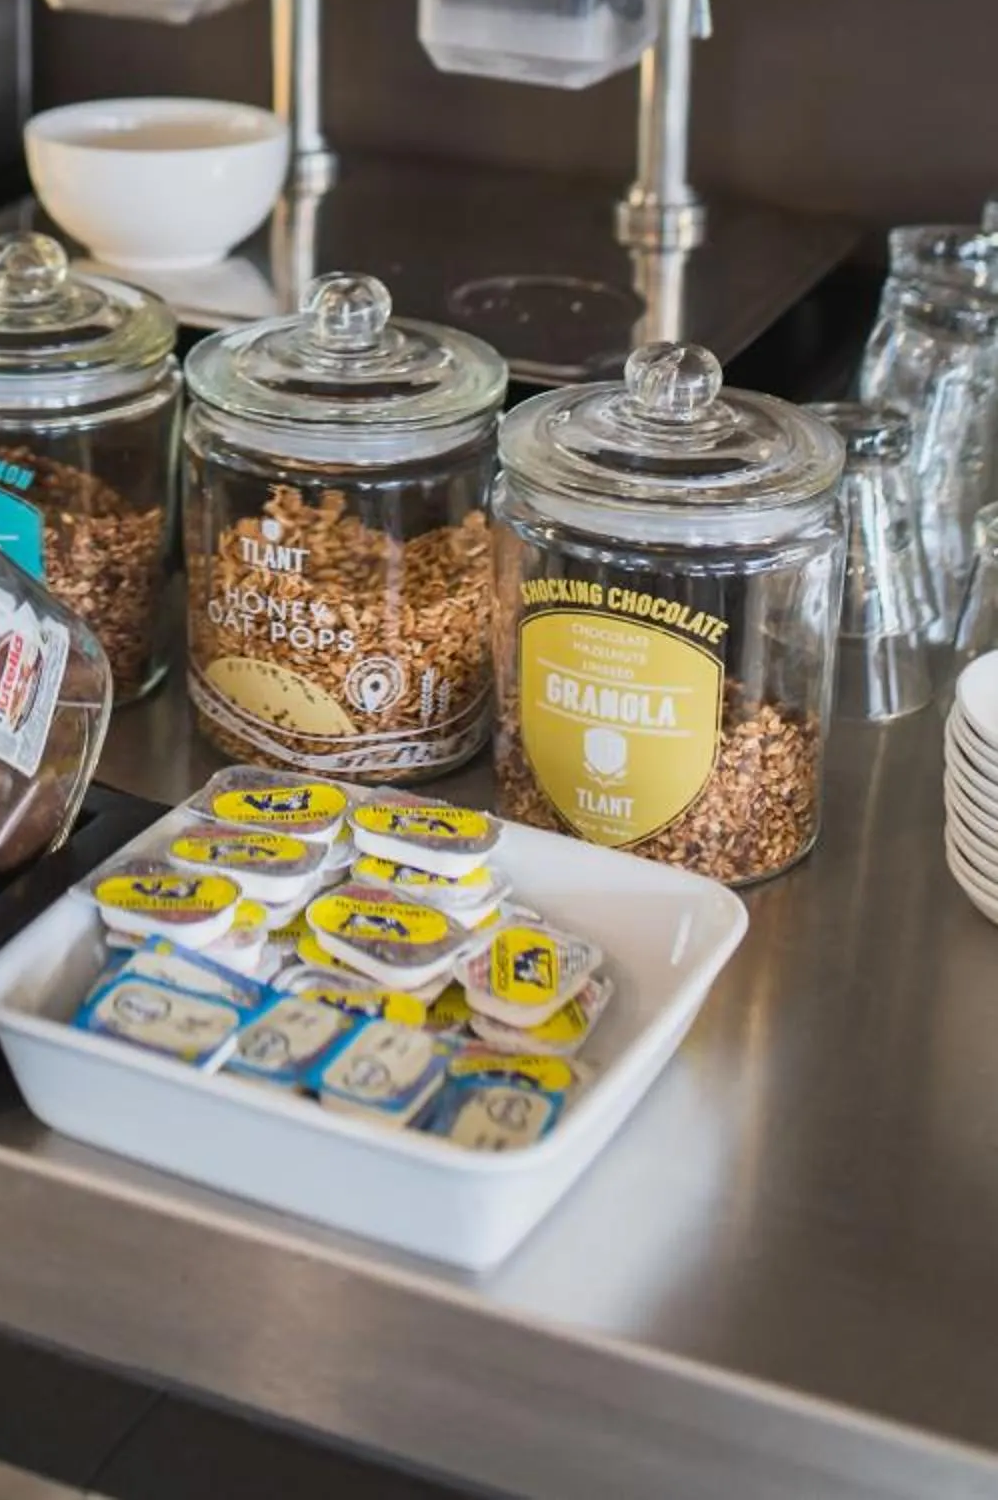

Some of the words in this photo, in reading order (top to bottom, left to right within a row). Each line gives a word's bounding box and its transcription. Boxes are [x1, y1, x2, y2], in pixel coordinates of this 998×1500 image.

[240, 536, 310, 572] TLANT
[208, 600, 254, 635] OAT
[271, 621, 355, 652] POPS
[224, 584, 329, 625] HONEY
[520, 579, 602, 606] SHOCKING
[607, 587, 729, 644] CHOCOLATE
[546, 672, 677, 727] GRANOLA
[575, 787, 635, 820] TLANT
